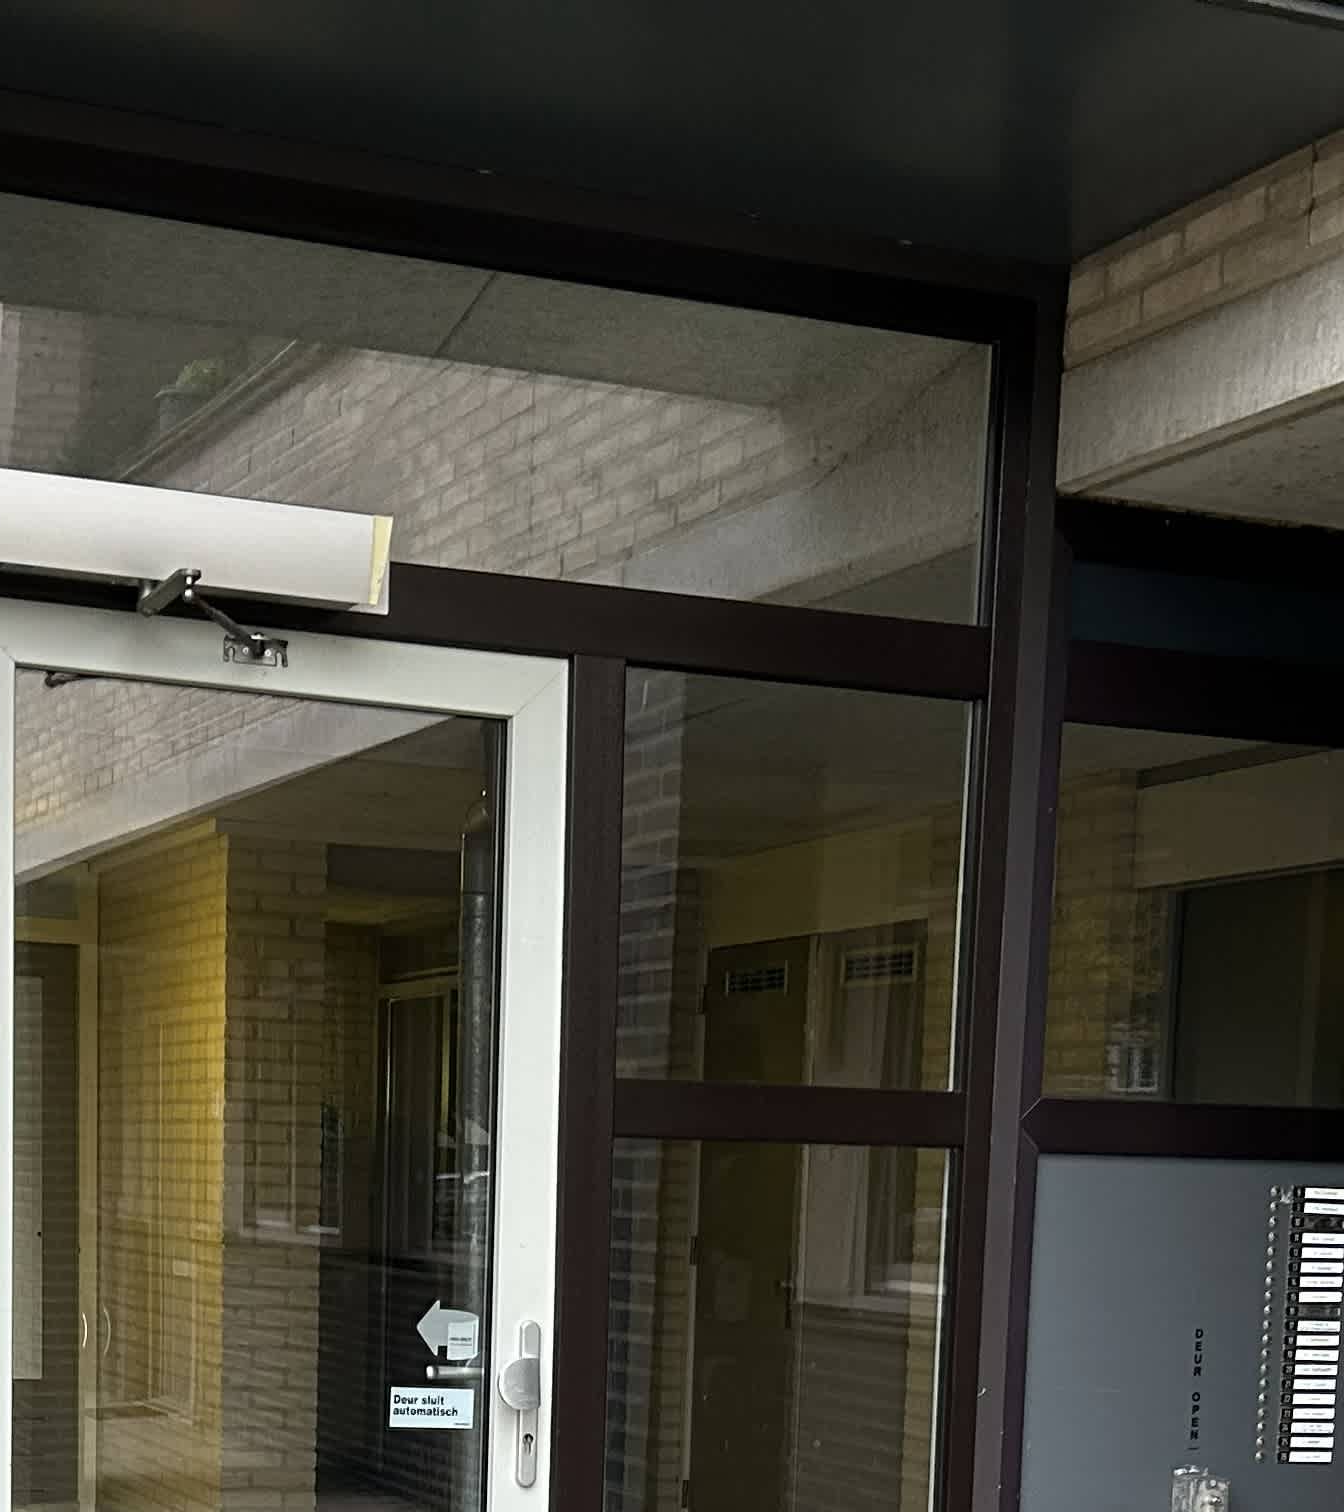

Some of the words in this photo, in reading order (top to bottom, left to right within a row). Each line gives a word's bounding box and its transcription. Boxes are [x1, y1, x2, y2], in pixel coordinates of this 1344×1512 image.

[1193, 1328, 1204, 1377] DEUR
[393, 1394, 418, 1405] Deur
[421, 1395, 444, 1406] sluit
[393, 1406, 458, 1417] automatisch
[1190, 1391, 1201, 1440] OPEN
